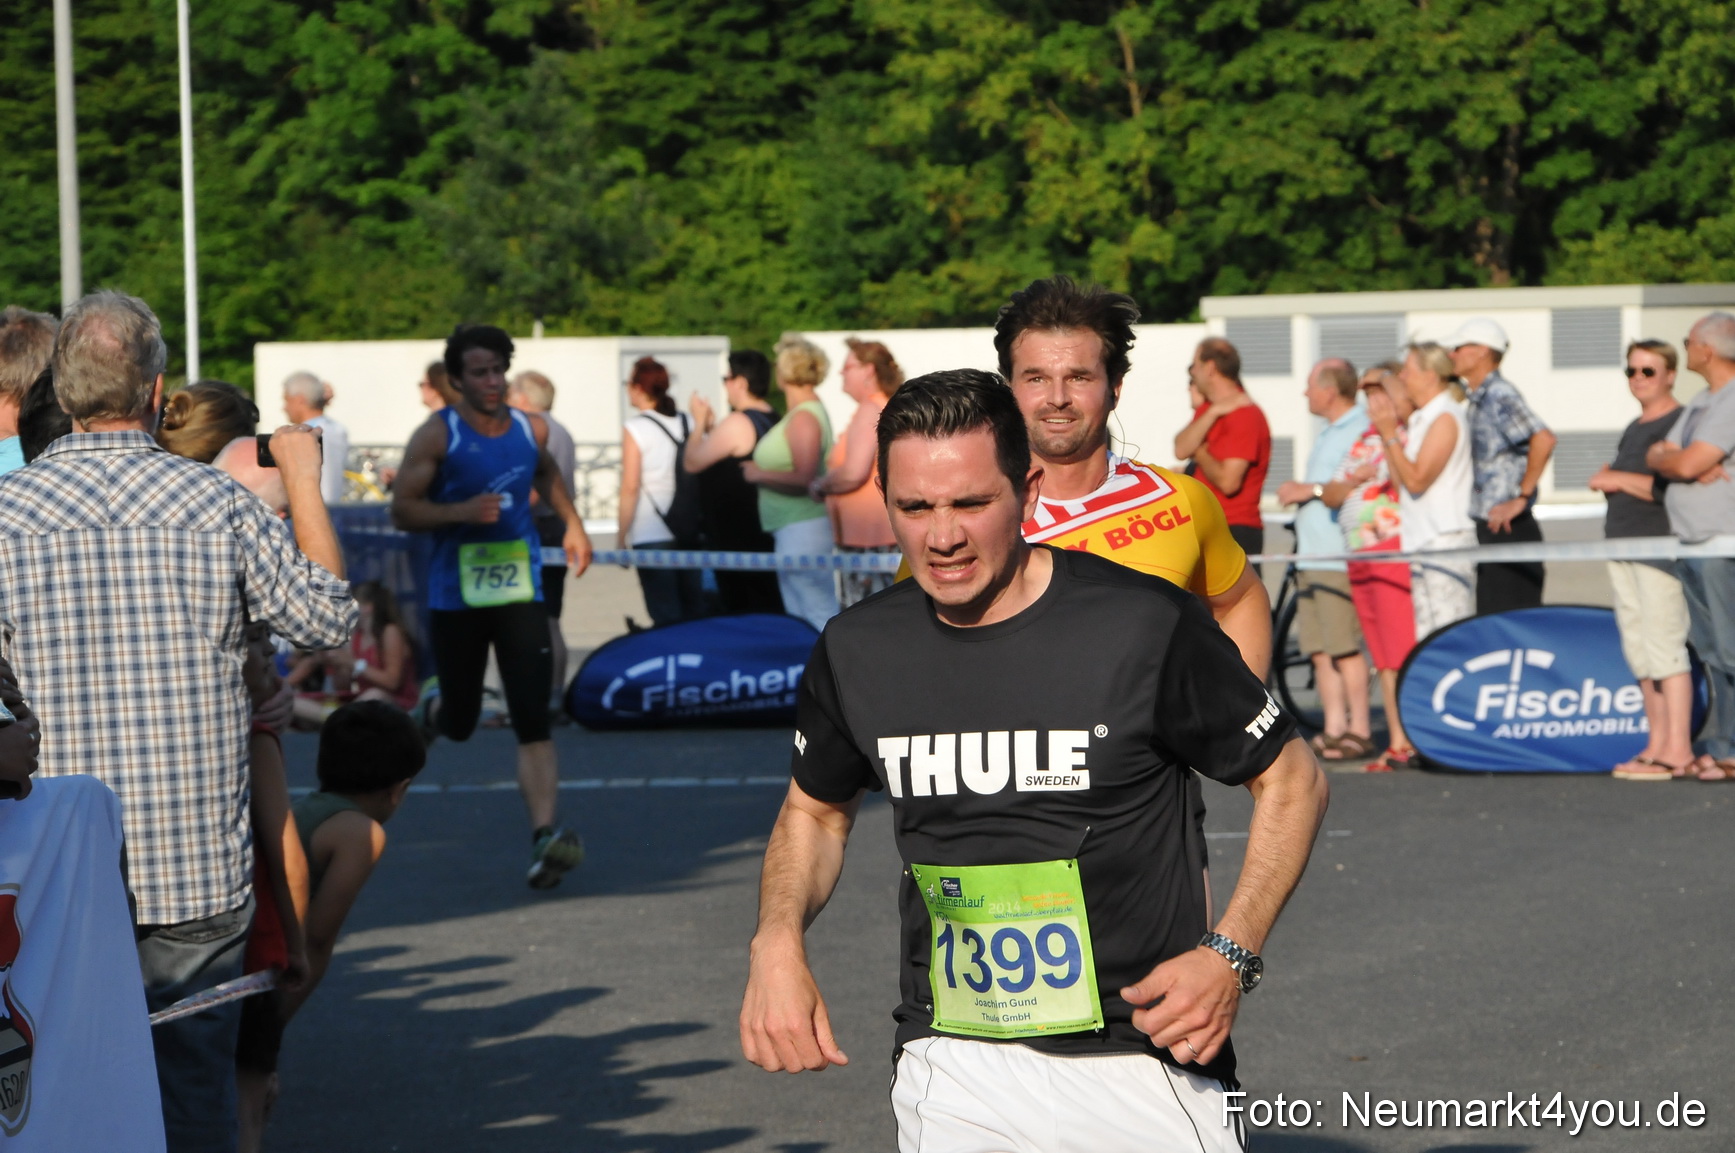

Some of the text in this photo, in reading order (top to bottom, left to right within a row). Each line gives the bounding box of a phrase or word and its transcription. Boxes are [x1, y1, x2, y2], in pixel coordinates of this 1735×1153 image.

[1103, 505, 1192, 551] BÖGL
[471, 563, 520, 590] 752
[642, 663, 806, 713] Fischer
[1474, 678, 1644, 722] Fische
[1244, 688, 1280, 740] THU
[1492, 716, 1650, 739] AUTOMOBILE
[877, 730, 1090, 799] THULE
[1025, 775, 1081, 786] SWEDEN
[988, 901, 1022, 915] 2014
[937, 922, 1083, 994] 1399
[974, 996, 1038, 1009] Joachim Gund
[981, 1012, 1031, 1023] Thule GmbH
